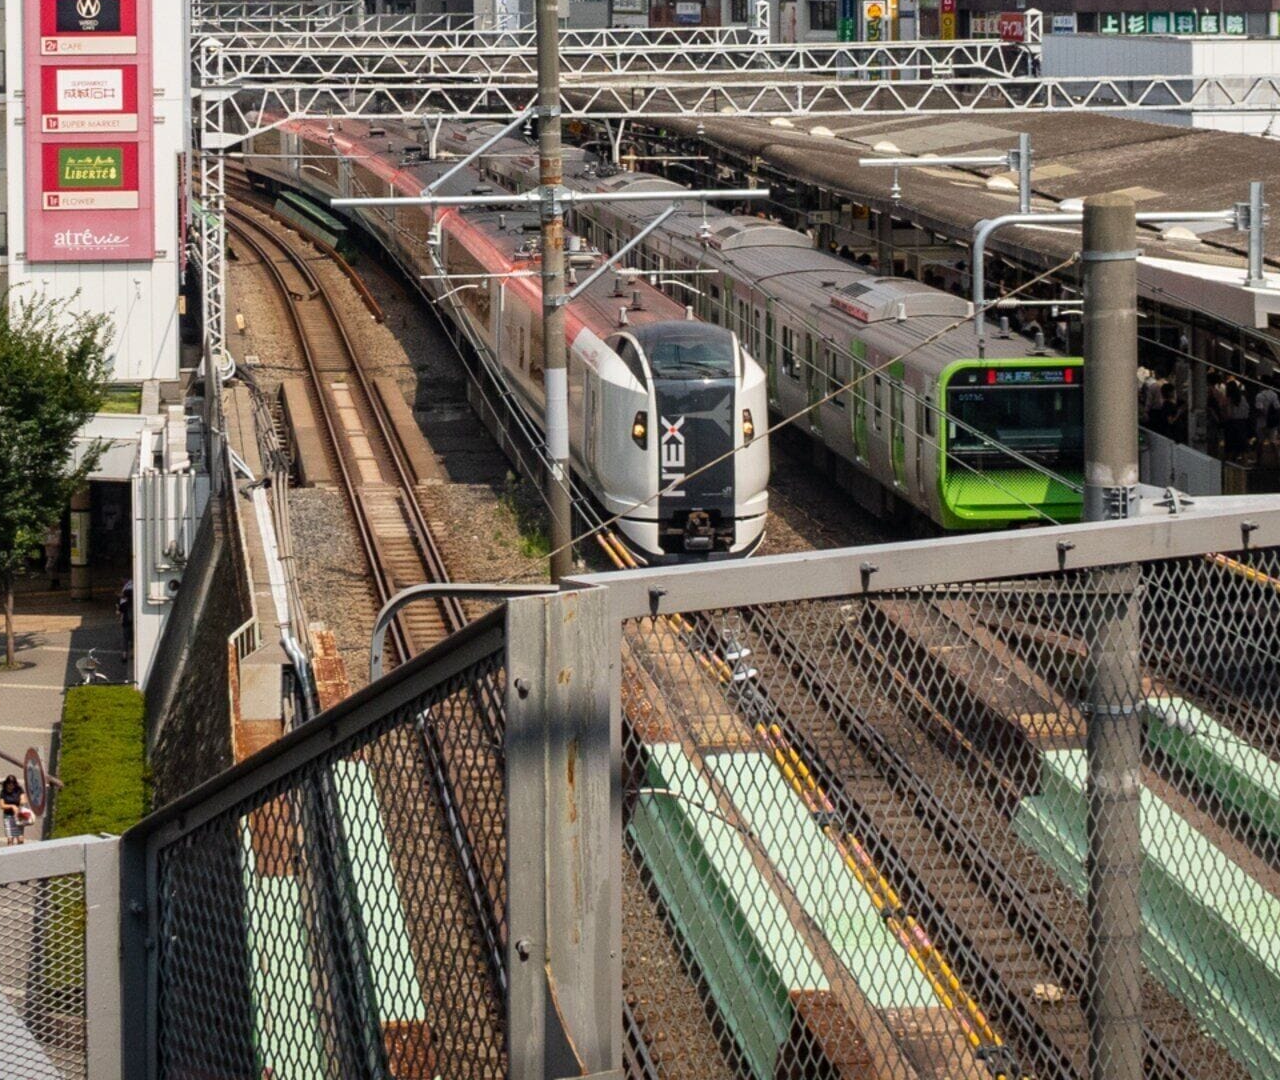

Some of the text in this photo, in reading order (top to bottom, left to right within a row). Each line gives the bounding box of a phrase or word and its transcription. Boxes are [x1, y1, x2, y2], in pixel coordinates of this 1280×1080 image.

[1102, 15, 1245, 34] 上杉歯科医院
[61, 43, 82, 51] CAFE
[61, 119, 86, 128] SUPER
[88, 119, 120, 127] MARKET
[62, 198, 96, 206] FLOWER
[54, 228, 93, 246] atré
